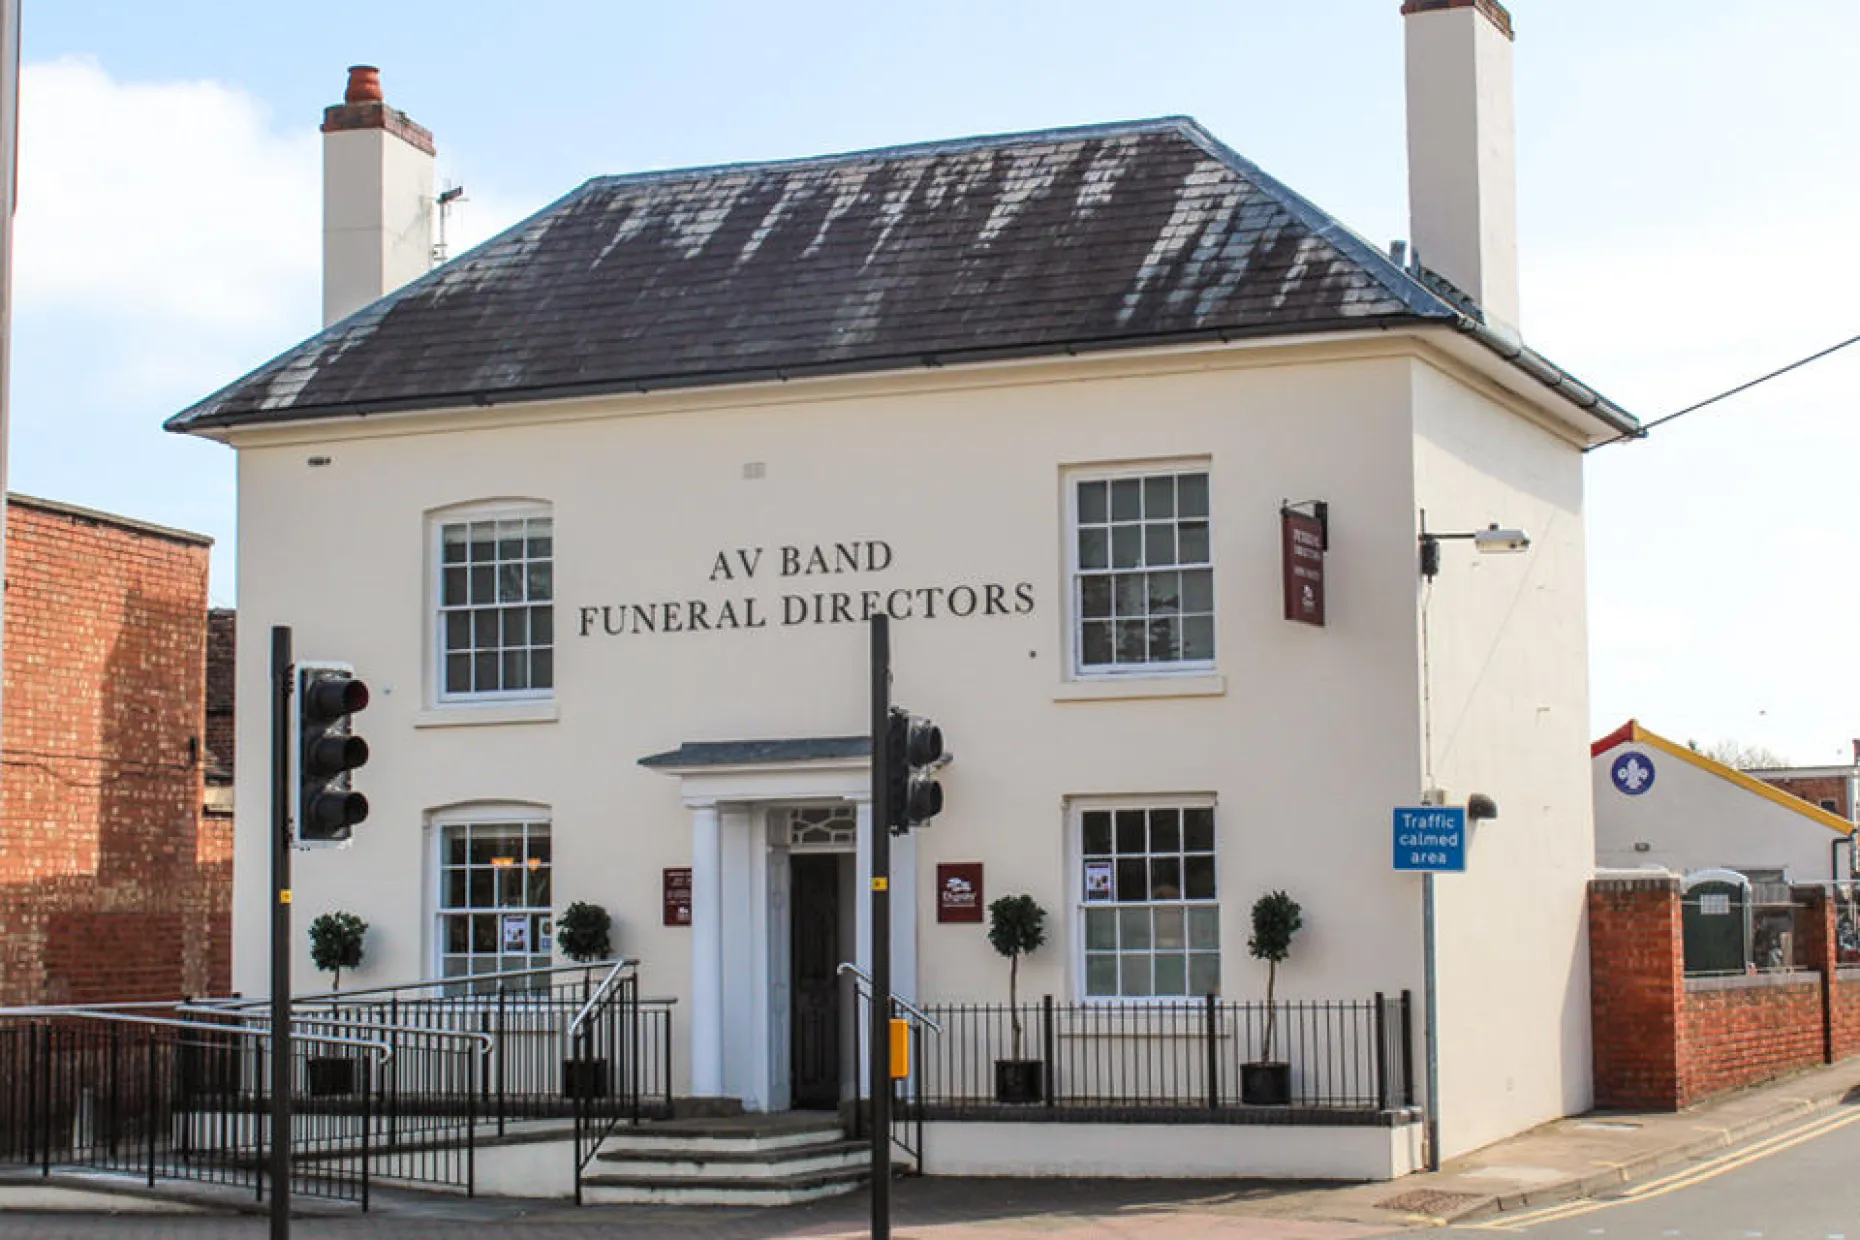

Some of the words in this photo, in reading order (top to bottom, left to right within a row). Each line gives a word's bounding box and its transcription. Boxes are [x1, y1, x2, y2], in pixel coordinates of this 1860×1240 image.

[709, 547, 763, 581] AV
[780, 540, 892, 577] BAND
[578, 598, 766, 636] FUNERAL
[781, 582, 1035, 626] DIRECTORS
[1401, 813, 1455, 829] Traffic
[1399, 832, 1458, 847] calmed
[1411, 851, 1446, 865] area
